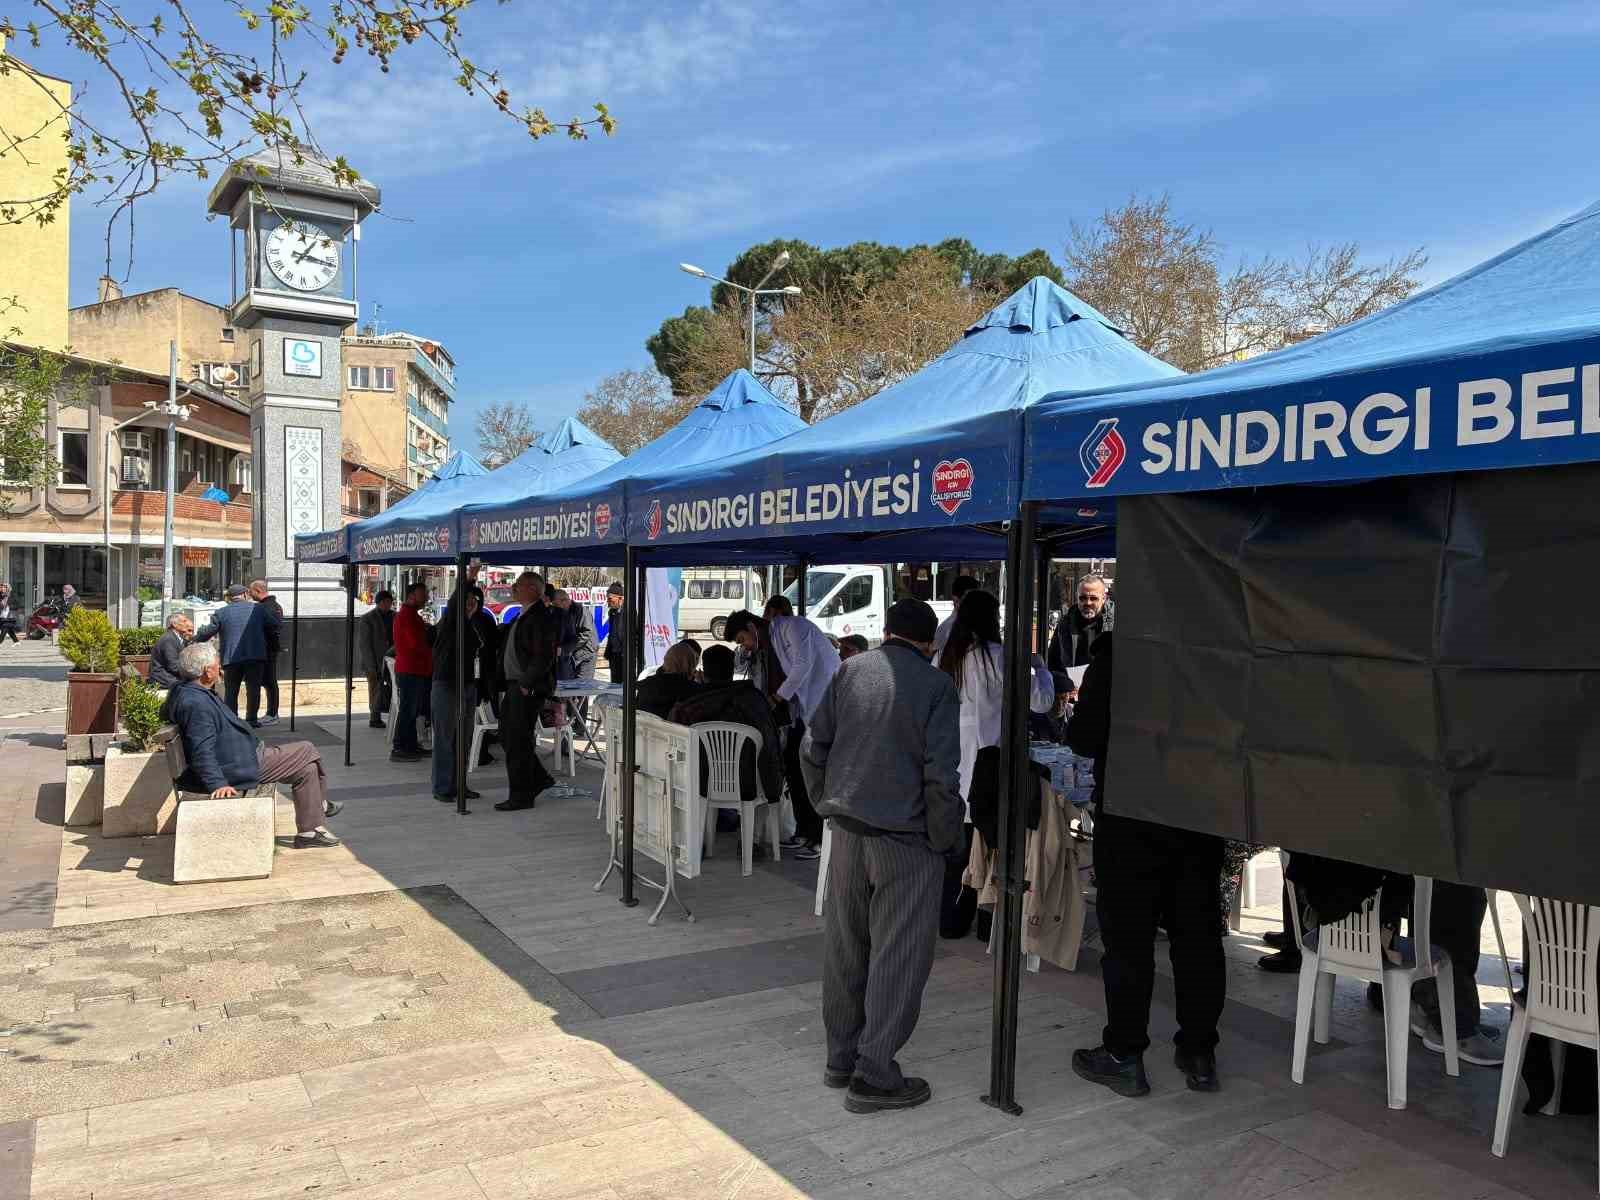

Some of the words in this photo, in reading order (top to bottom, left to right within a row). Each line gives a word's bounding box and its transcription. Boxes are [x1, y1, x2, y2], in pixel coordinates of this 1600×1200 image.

[1140, 387, 1432, 475] SINDIRGI
[666, 493, 754, 533] SINDIRGI
[759, 459, 920, 525] BELEDİYESİ
[936, 469, 969, 481] SINDIRGI
[479, 518, 521, 544] SINDIRGI
[523, 503, 592, 541] BELEDİYESİ
